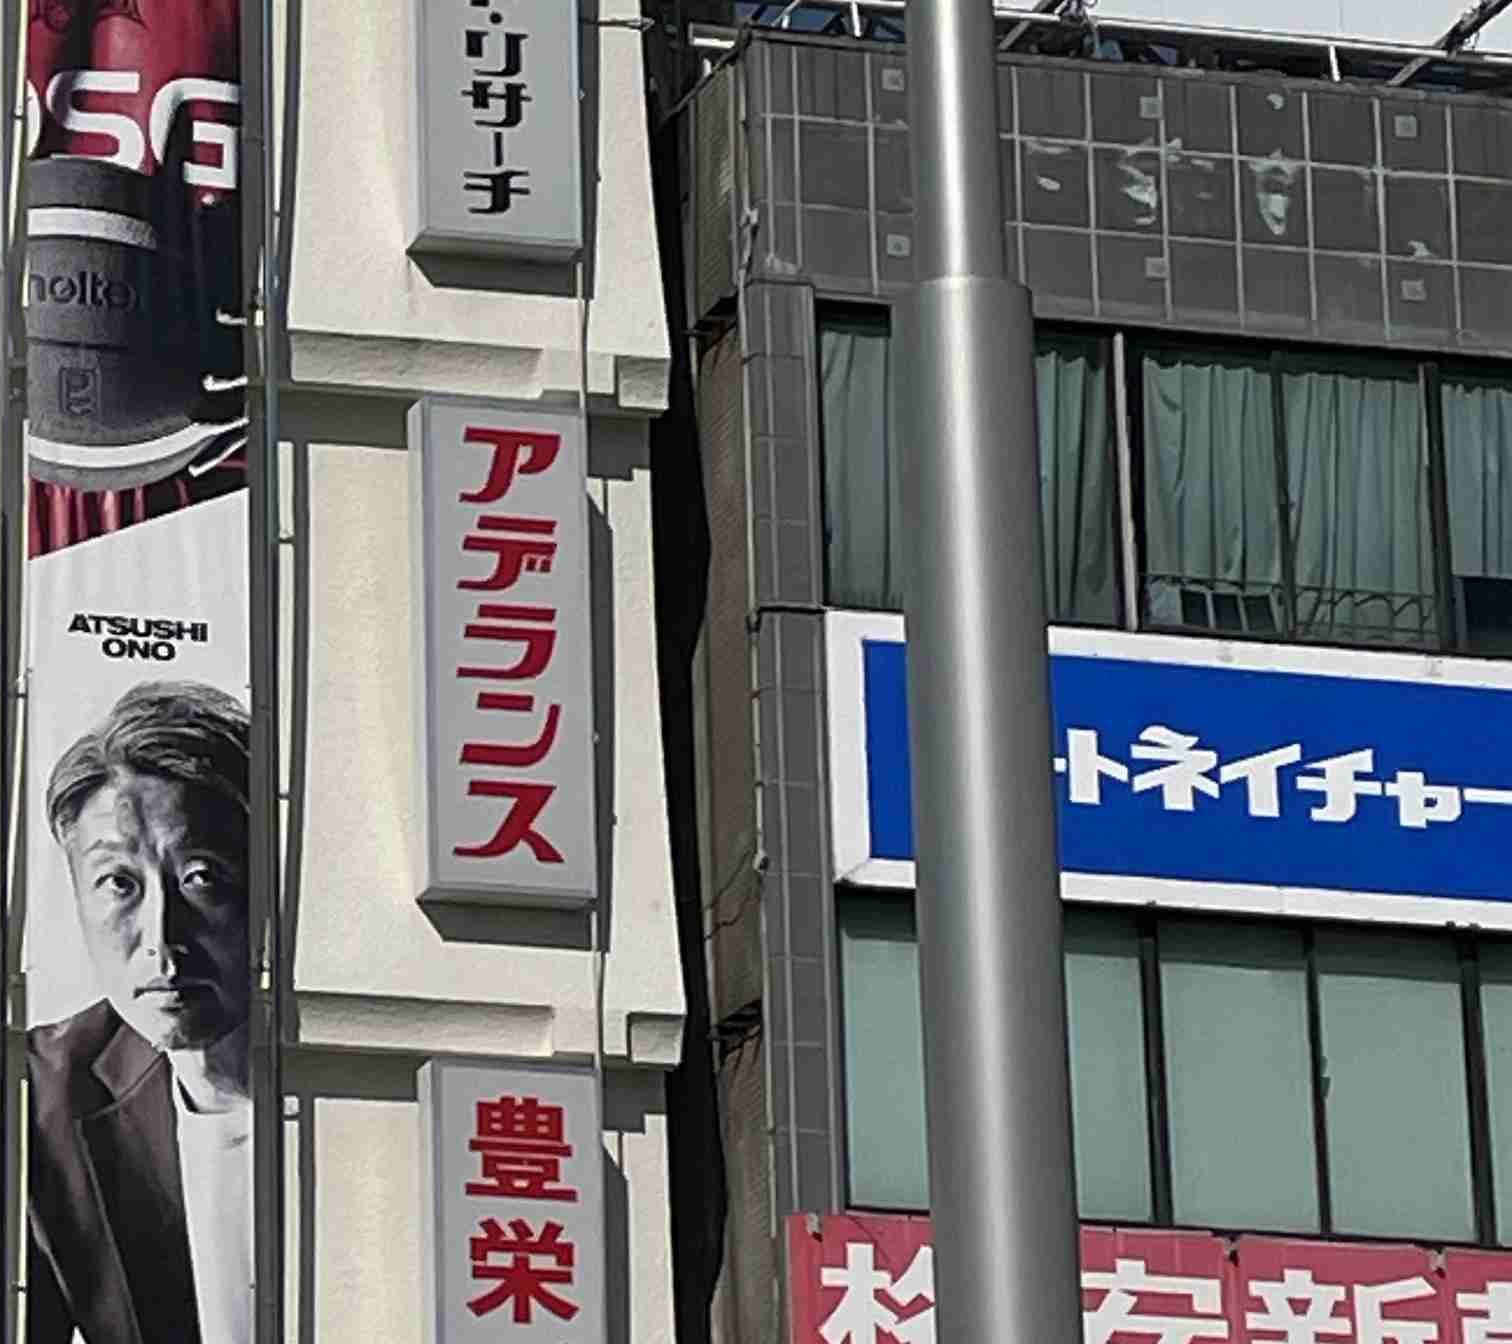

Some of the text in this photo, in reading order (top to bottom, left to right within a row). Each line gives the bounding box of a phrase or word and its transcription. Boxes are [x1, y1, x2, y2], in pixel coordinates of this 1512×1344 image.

[26, 70, 246, 190] SG
[67, 613, 208, 643] ATSUSHI
[102, 638, 177, 662] ONO
[452, 425, 565, 864] アデランス
[1053, 725, 1512, 829] トネイチャー
